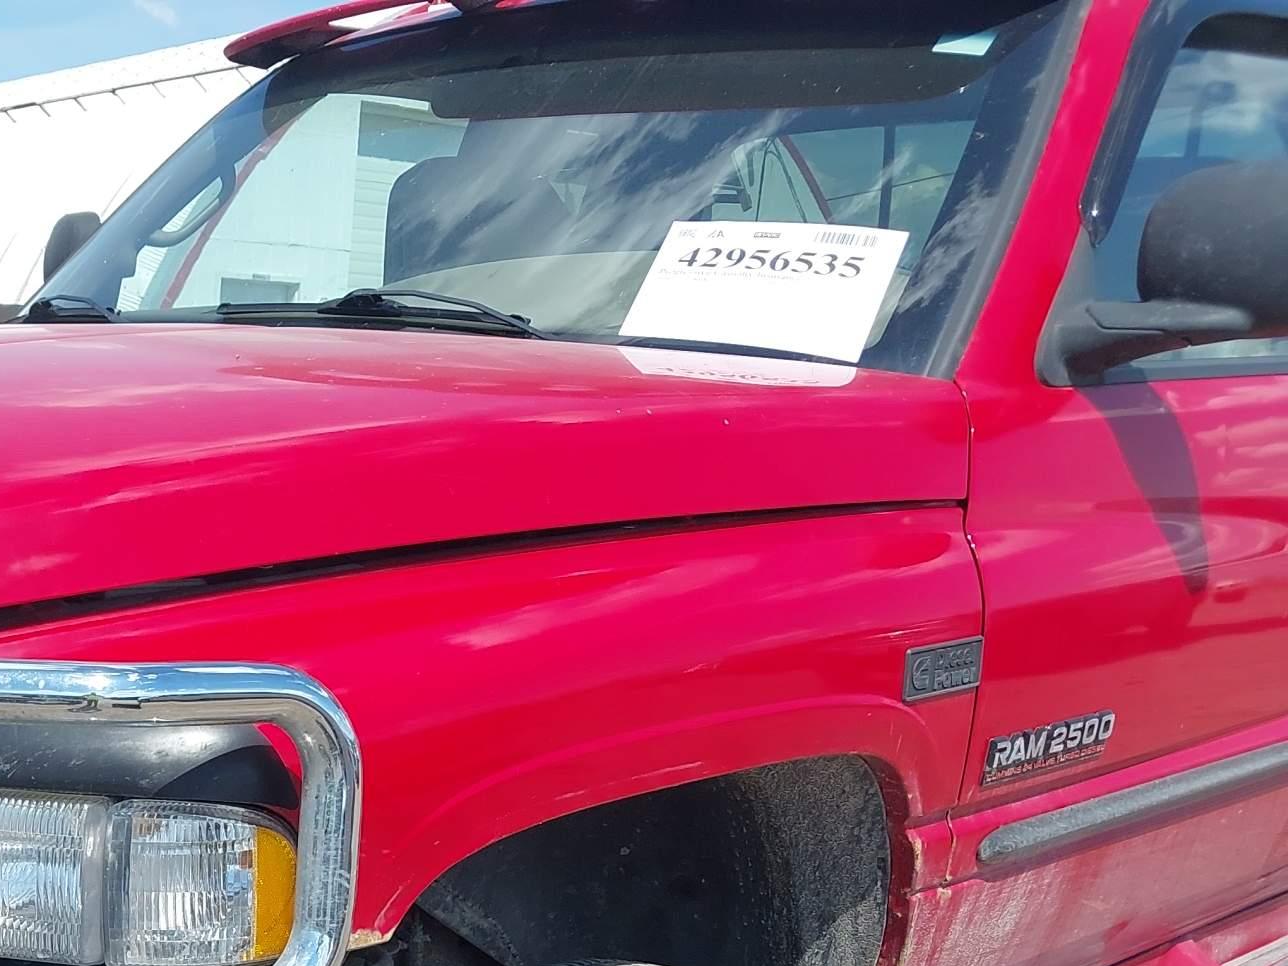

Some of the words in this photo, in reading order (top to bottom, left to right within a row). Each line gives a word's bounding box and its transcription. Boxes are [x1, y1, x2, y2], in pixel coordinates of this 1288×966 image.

[678, 247, 865, 278] 42956535
[992, 731, 1048, 768] RAM
[1050, 713, 1115, 753] 2500
